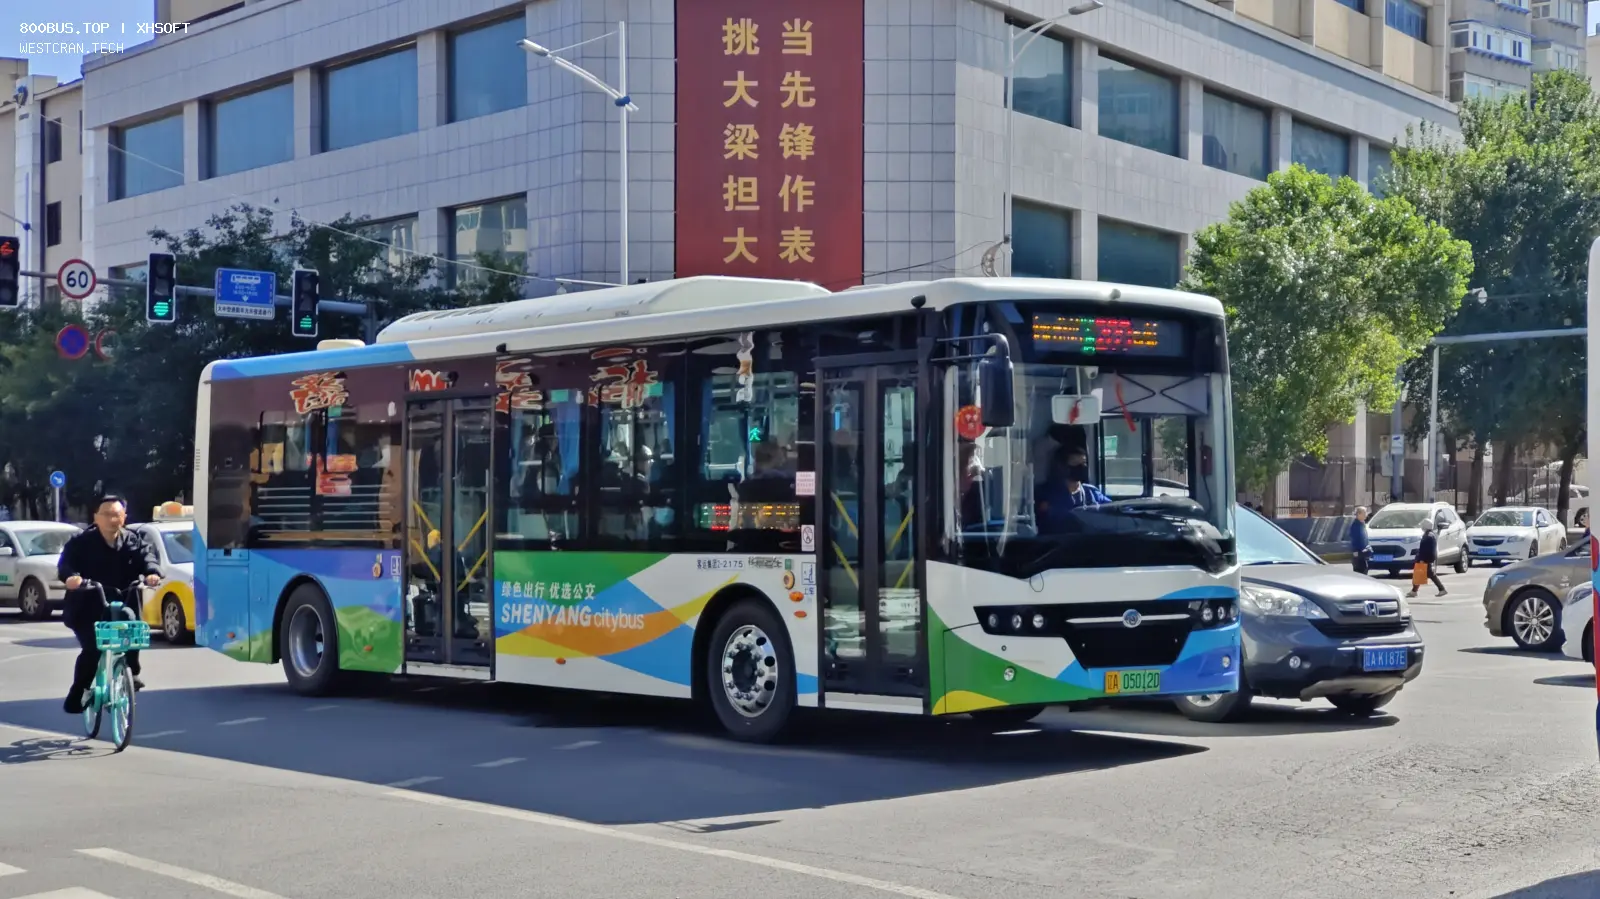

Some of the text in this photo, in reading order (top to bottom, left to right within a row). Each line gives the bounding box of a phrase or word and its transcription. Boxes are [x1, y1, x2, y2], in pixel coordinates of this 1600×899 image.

[722, 17, 760, 264] 挑大梁担大
[778, 18, 816, 264] 当先锋作表
[66, 270, 88, 288] 60
[501, 581, 596, 600] 绿色出行 优选公交
[501, 603, 645, 633] SHENYANG citybus
